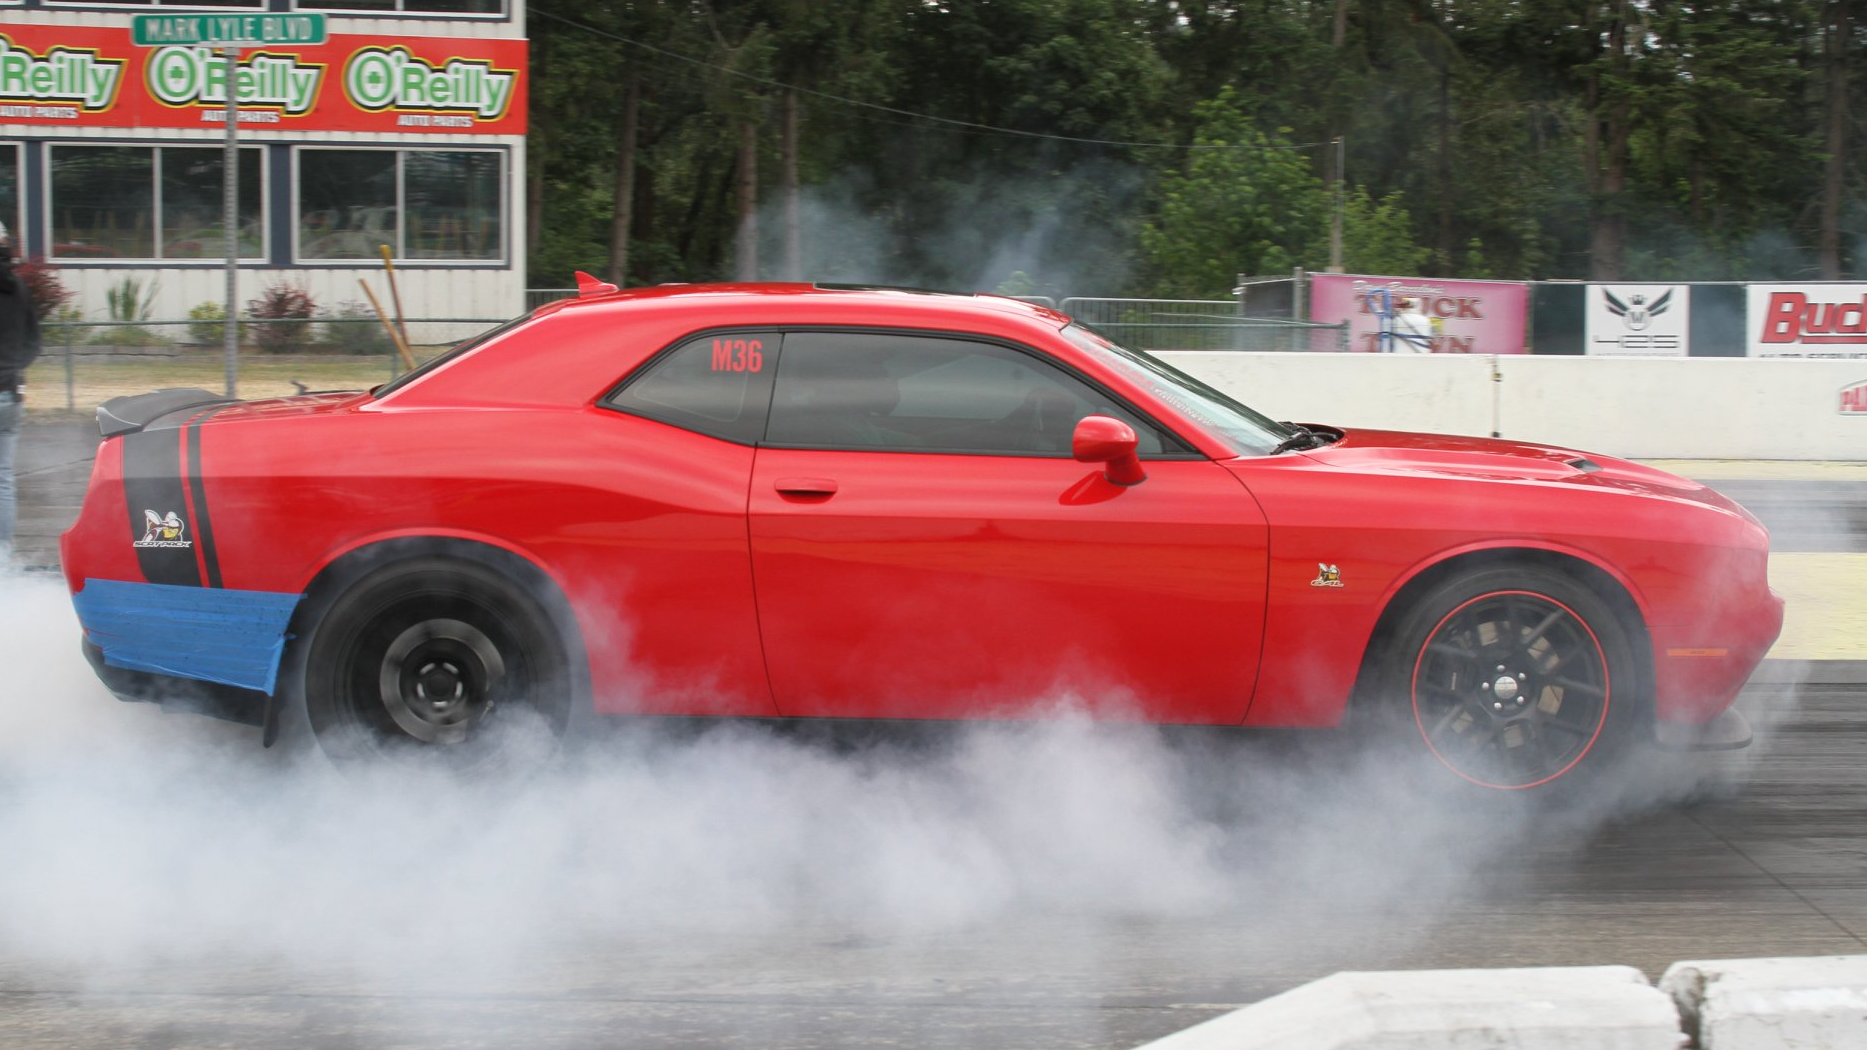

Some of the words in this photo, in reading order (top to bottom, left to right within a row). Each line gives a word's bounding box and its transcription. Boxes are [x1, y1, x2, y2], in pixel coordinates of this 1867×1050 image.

[145, 18, 200, 41] MARK
[206, 17, 256, 41] LYLE
[262, 17, 313, 40] BLVD
[151, 46, 318, 110] O'Reilly
[349, 51, 512, 115] O'Reilly
[35, 106, 78, 118] PARTS
[201, 109, 229, 122] AUT
[237, 111, 280, 123] PARTS
[397, 115, 430, 126] AUTO
[432, 116, 474, 127] PARTS
[1355, 293, 1484, 320] TCK
[1360, 332, 1477, 353] TWN
[711, 338, 763, 372] M36
